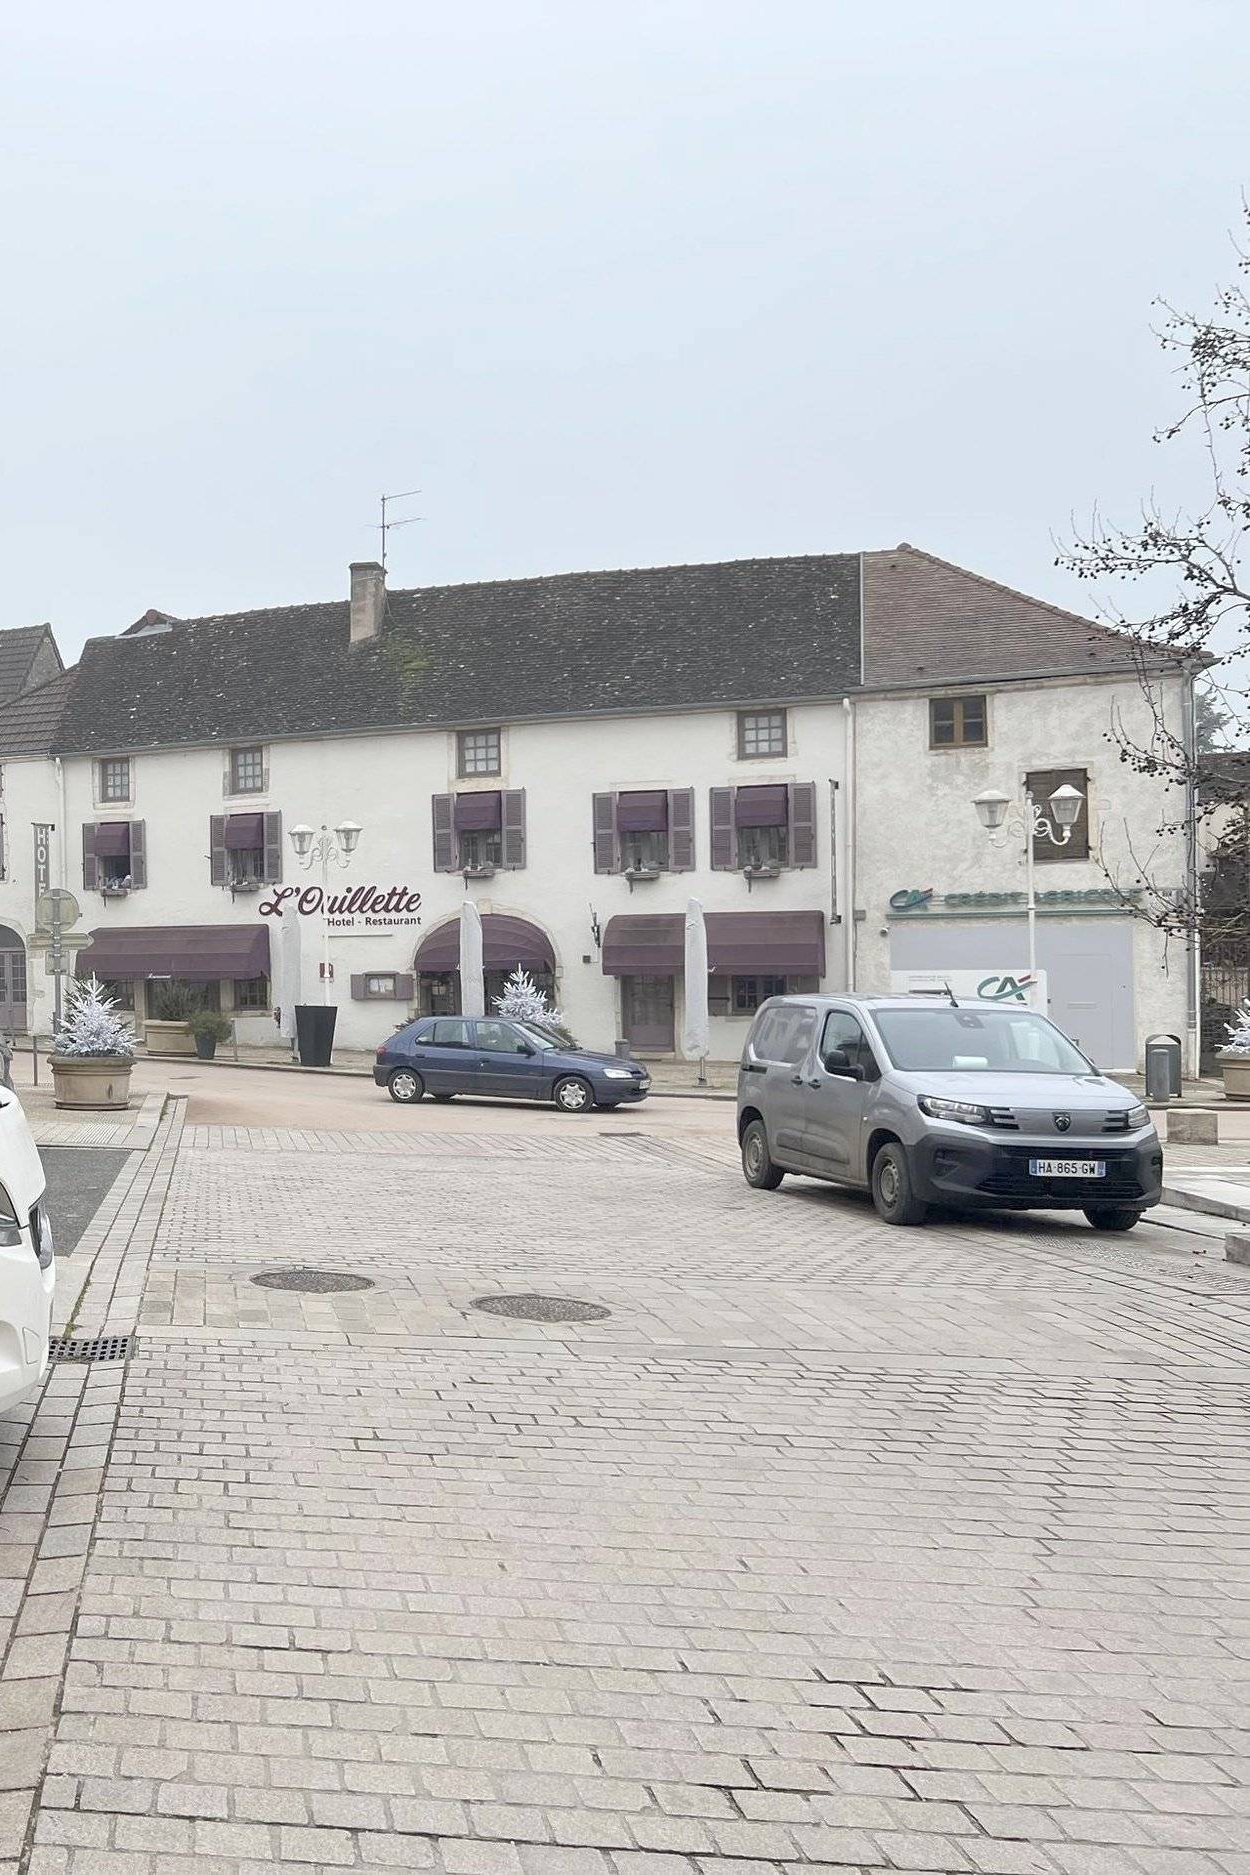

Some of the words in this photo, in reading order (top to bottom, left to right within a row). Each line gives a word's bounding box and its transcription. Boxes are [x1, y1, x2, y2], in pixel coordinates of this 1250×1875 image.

[37, 827, 47, 898] HOTE
[258, 885, 422, 917] L'Ouillette
[327, 917, 354, 927] Hotel
[365, 916, 422, 926] Restaurant
